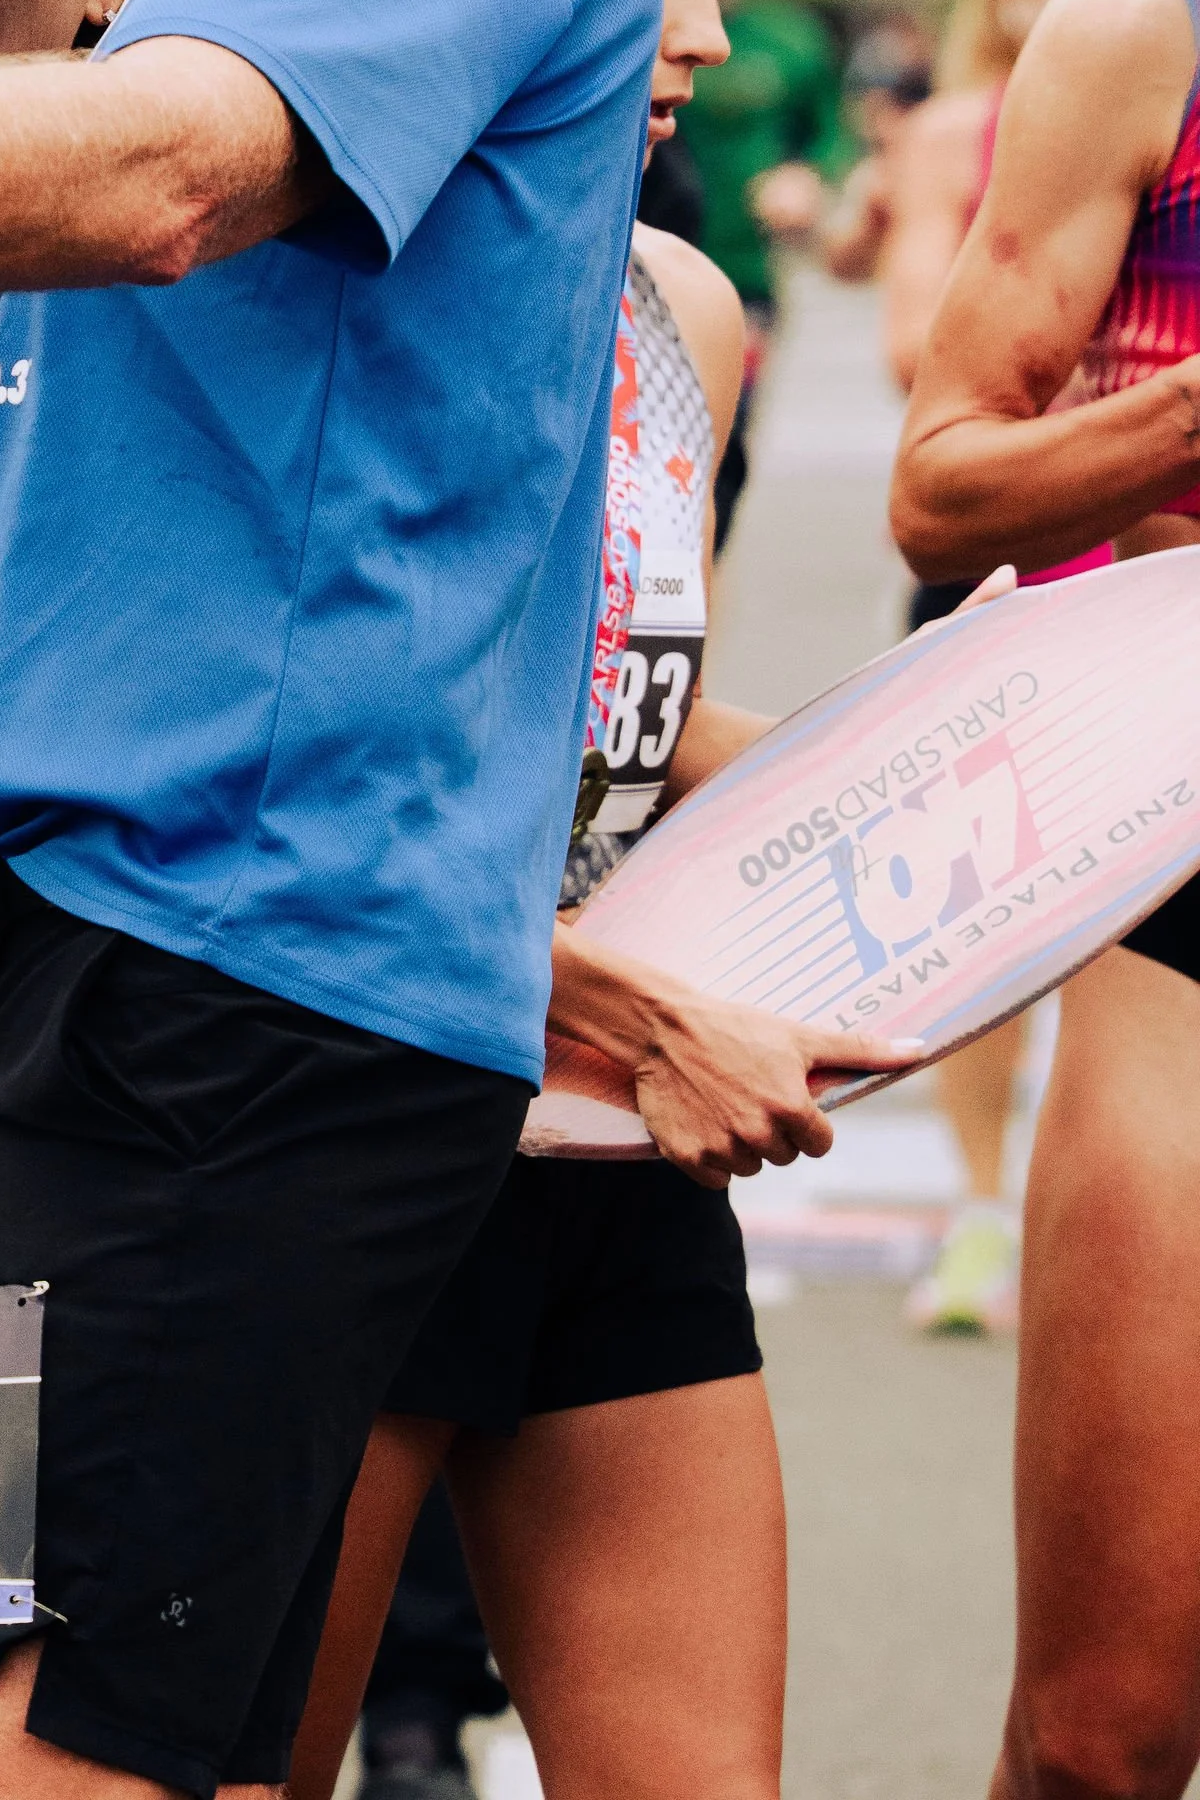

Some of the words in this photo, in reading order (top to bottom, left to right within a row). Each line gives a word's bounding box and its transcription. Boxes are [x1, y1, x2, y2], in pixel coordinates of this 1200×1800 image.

[603, 651, 692, 769] 83
[738, 670, 1040, 889] CARLSBAD5000
[1106, 778, 1197, 845] 2ND
[955, 847, 1100, 949] PLACE
